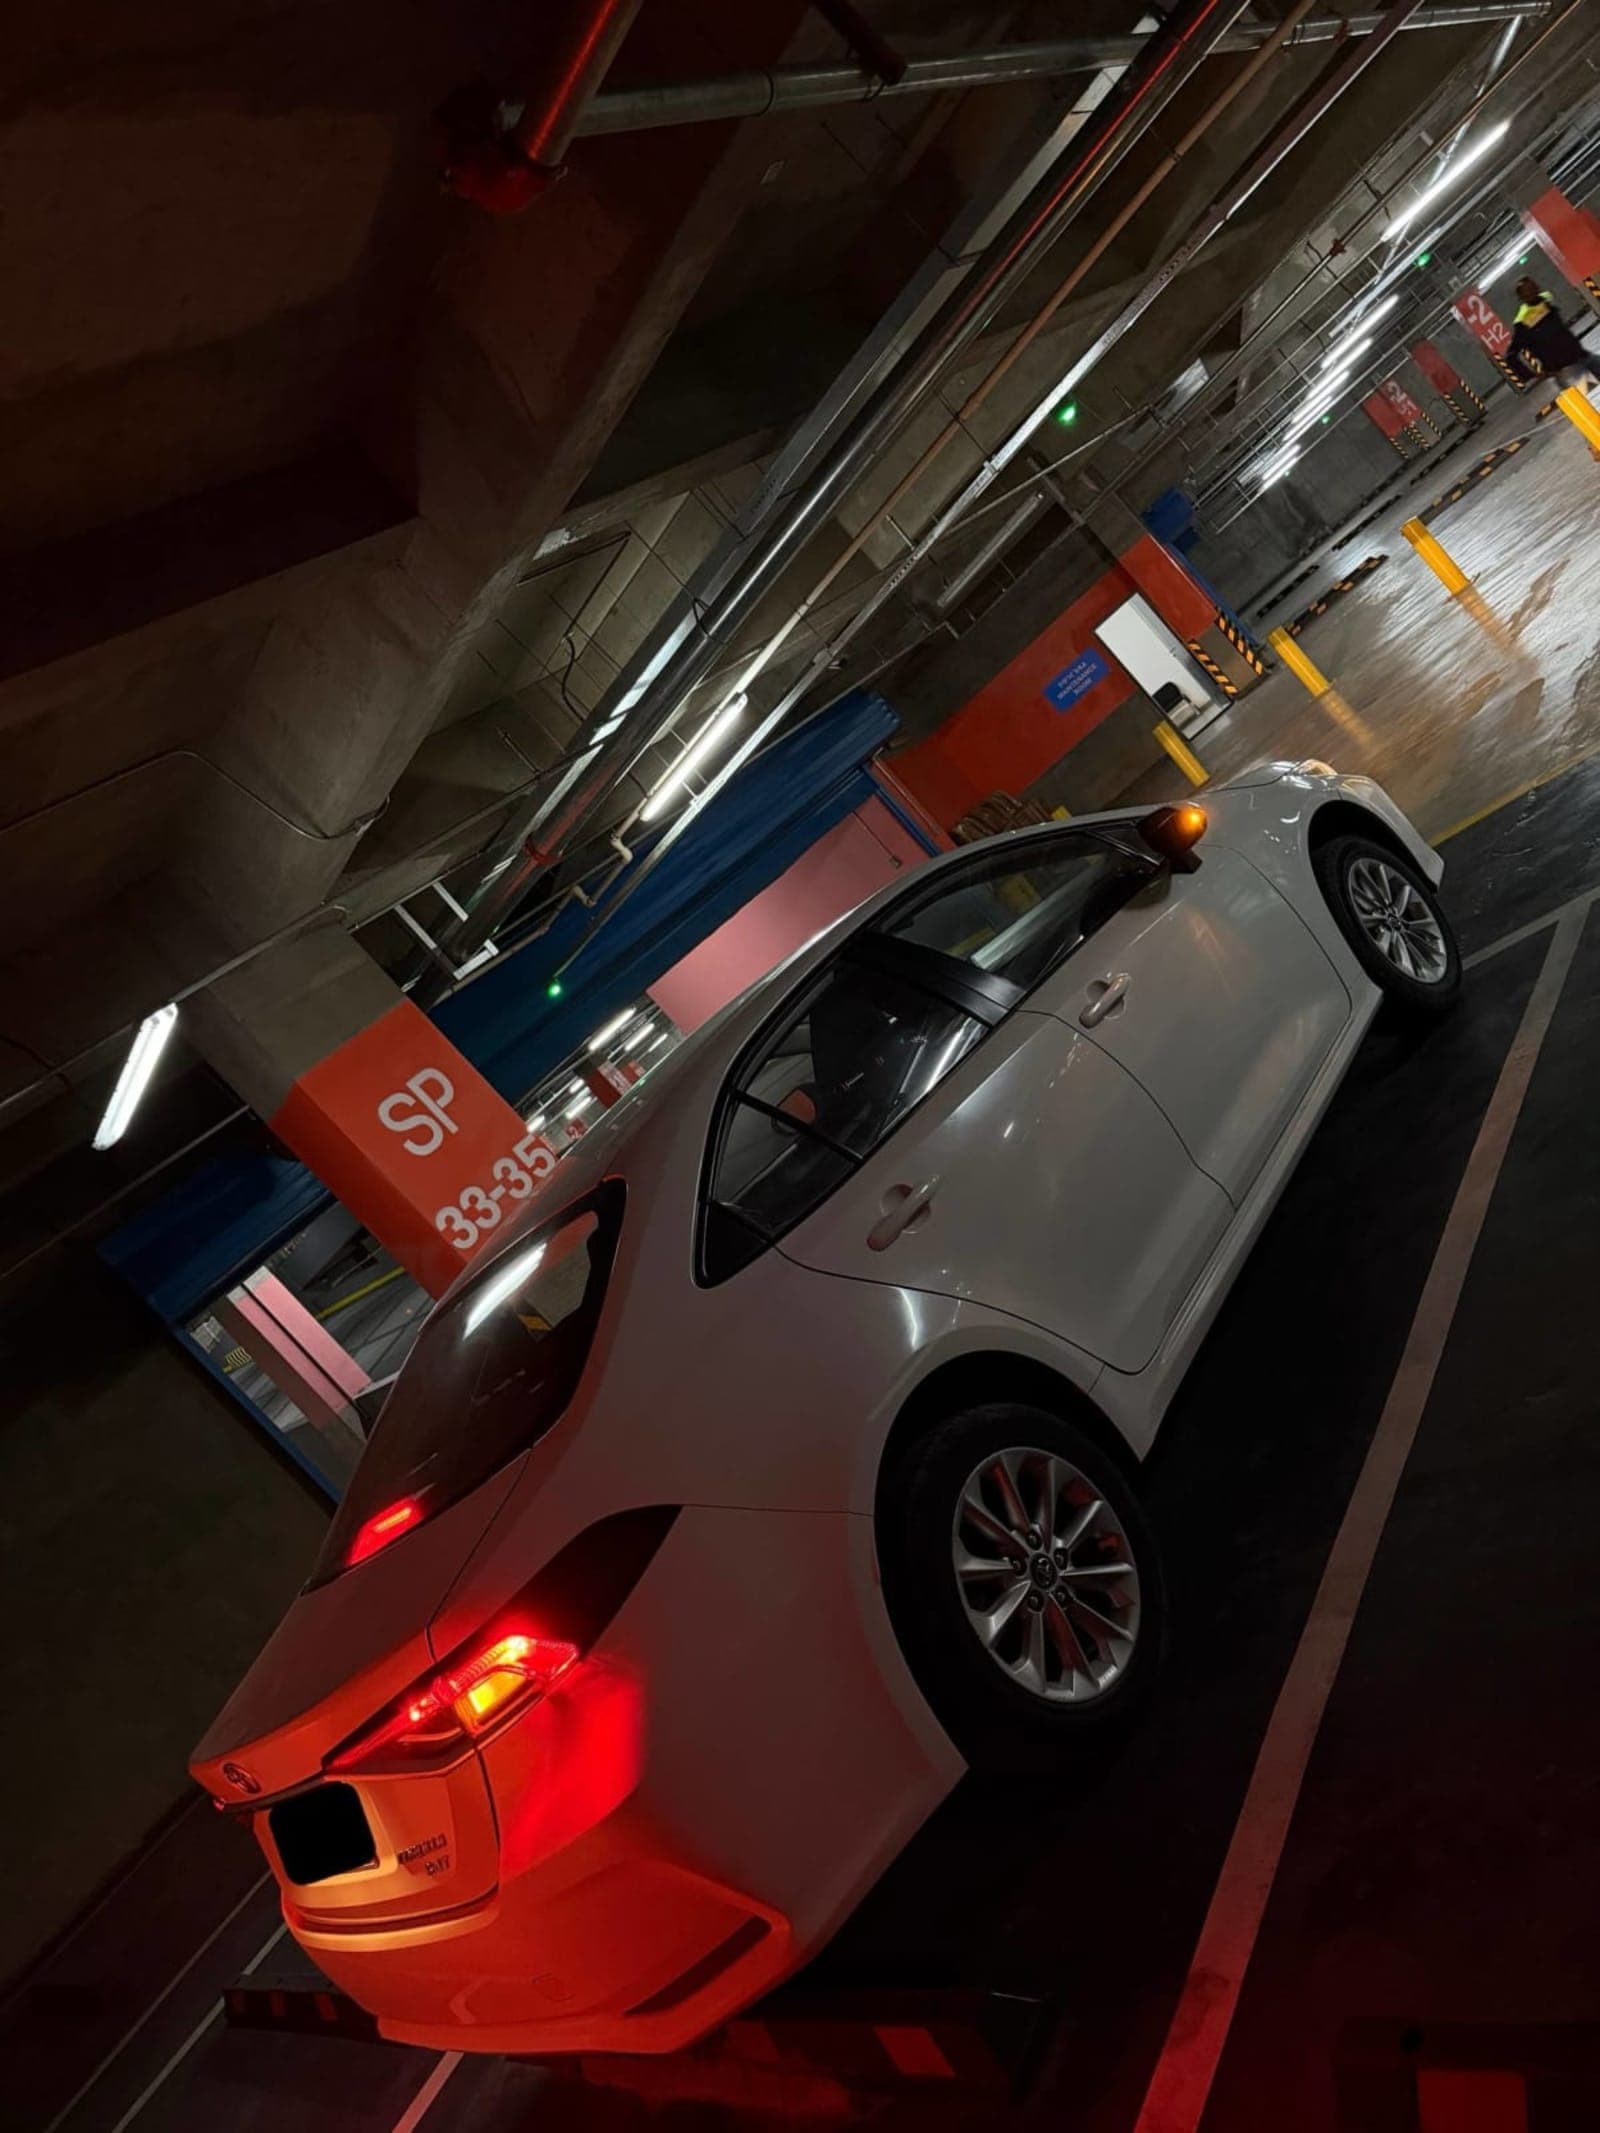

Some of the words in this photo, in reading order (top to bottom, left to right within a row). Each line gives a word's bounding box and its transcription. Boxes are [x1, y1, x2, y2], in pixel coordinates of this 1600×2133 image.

[1467, 295, 1495, 325] -2
[1481, 322, 1510, 350] H2
[378, 1067, 459, 1156] SP
[435, 1134, 555, 1248] 33-35
